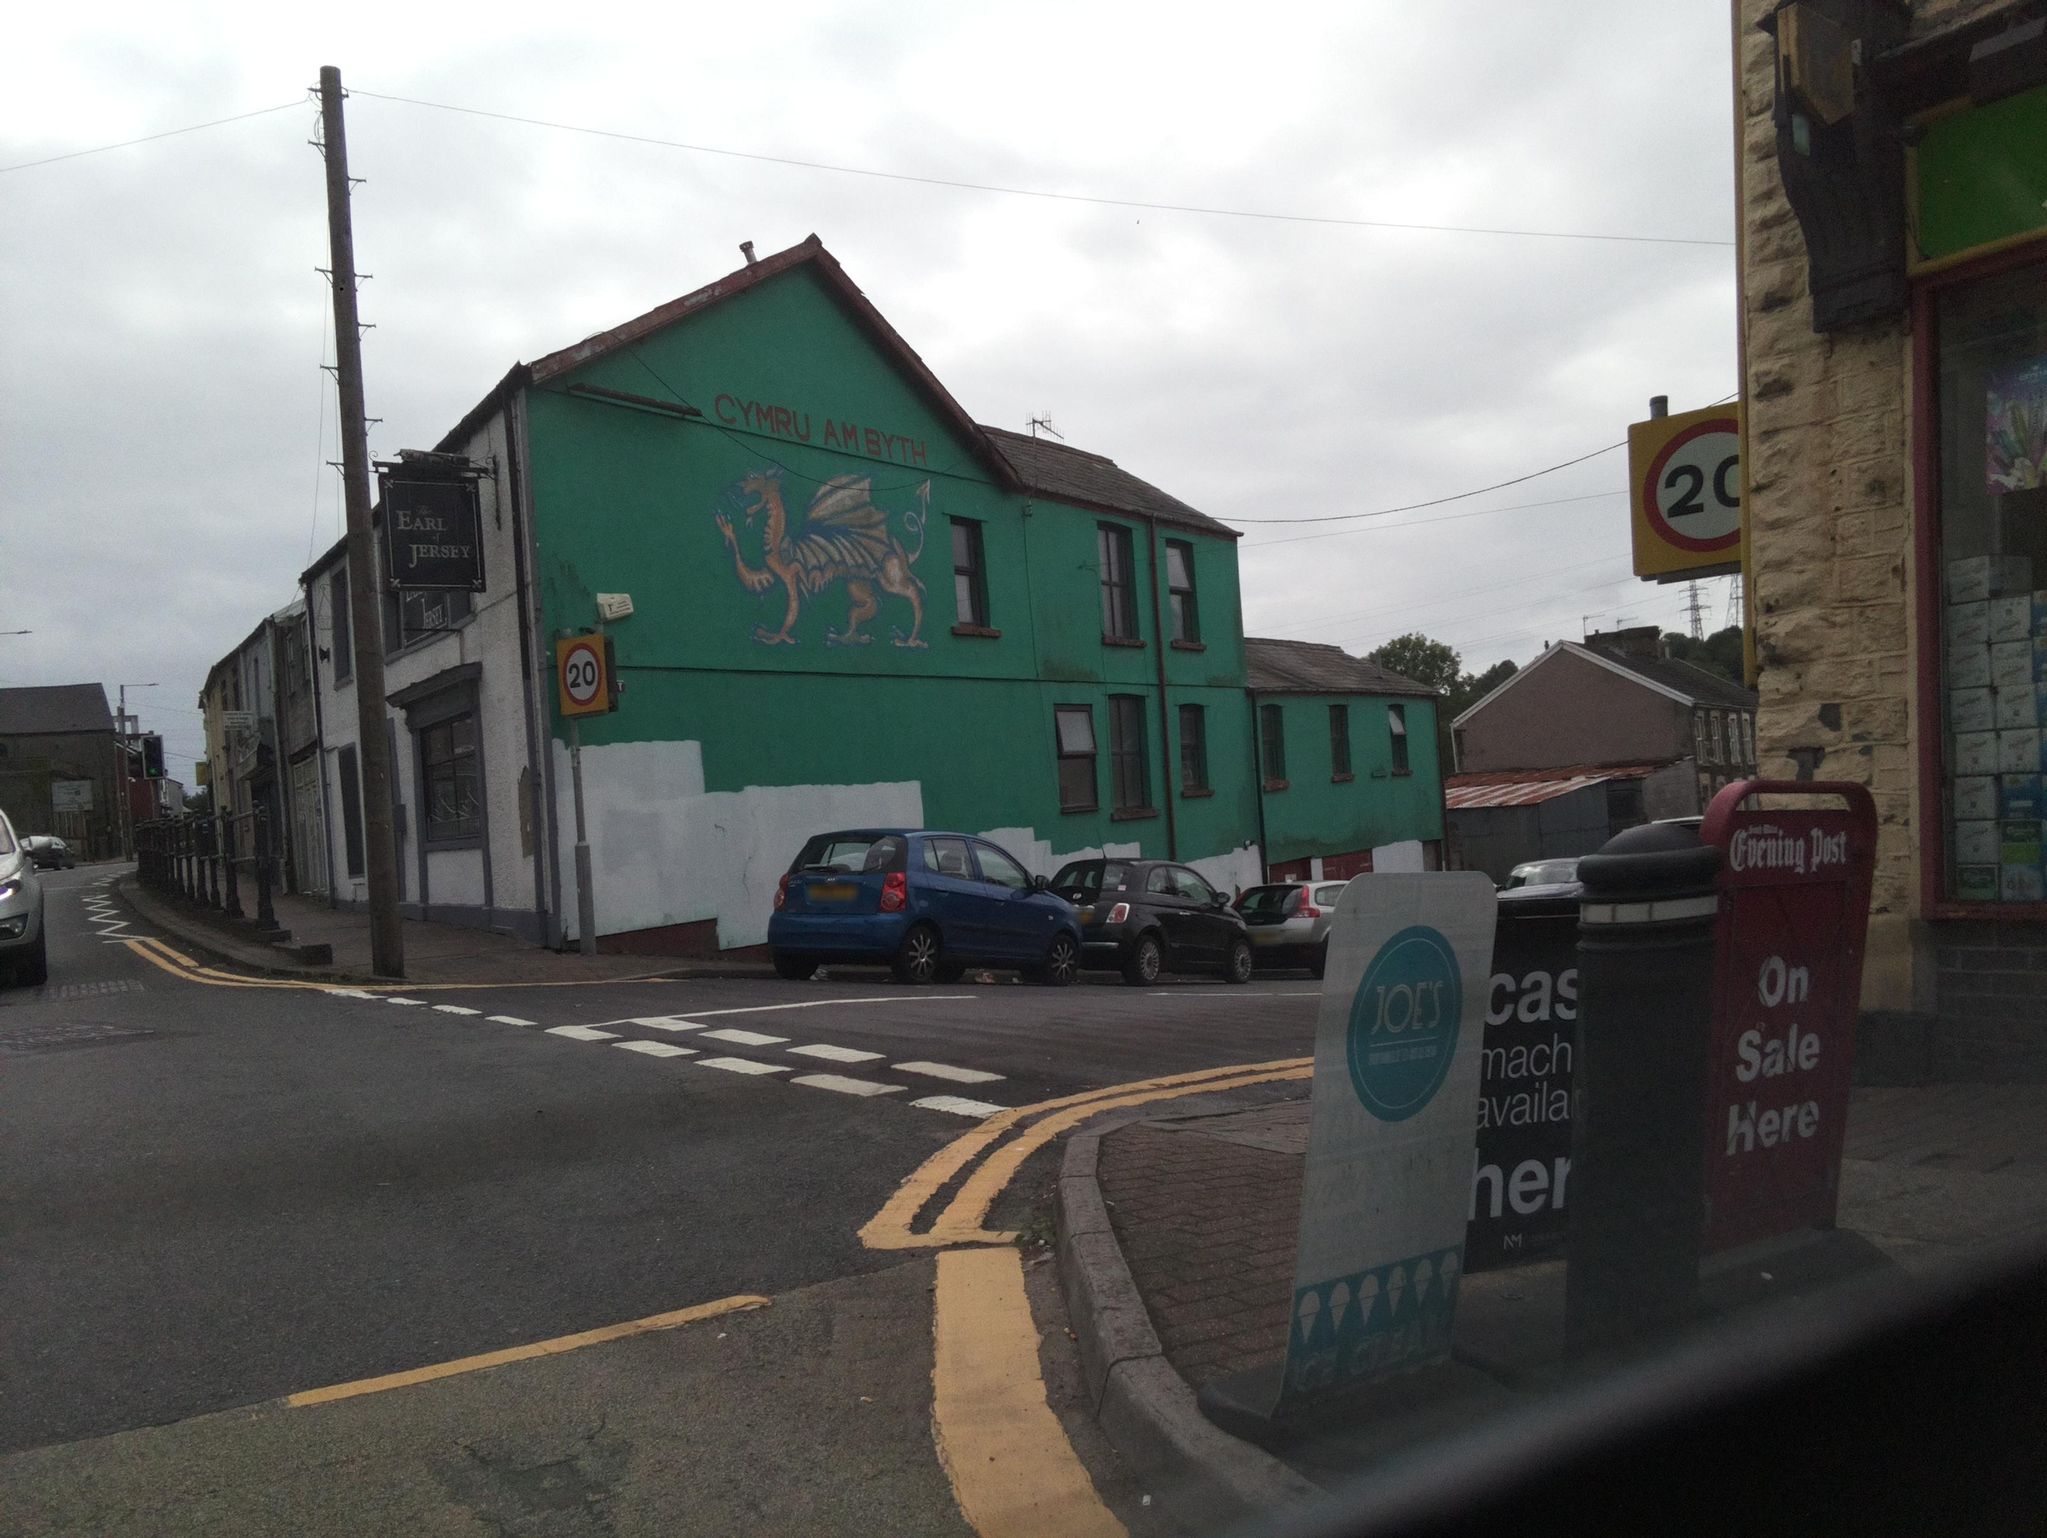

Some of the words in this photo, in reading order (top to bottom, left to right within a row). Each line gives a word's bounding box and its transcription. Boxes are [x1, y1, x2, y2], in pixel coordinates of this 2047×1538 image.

[714, 394, 811, 442] CYMRU
[824, 418, 860, 451] AM
[864, 428, 927, 466] BYTH
[396, 510, 447, 531] EARL
[408, 544, 471, 568] JERSEY
[568, 660, 596, 689] 20
[1729, 828, 1805, 875] Evening
[1810, 827, 1848, 873] Post
[1484, 968, 1578, 1026] cas
[1758, 955, 1809, 1008] On
[1481, 1032, 1573, 1080] mach
[1735, 1023, 1820, 1083] Sale
[1476, 1080, 1570, 1130] availa
[1725, 1100, 1820, 1157] Here
[1467, 1147, 1572, 1221] her
